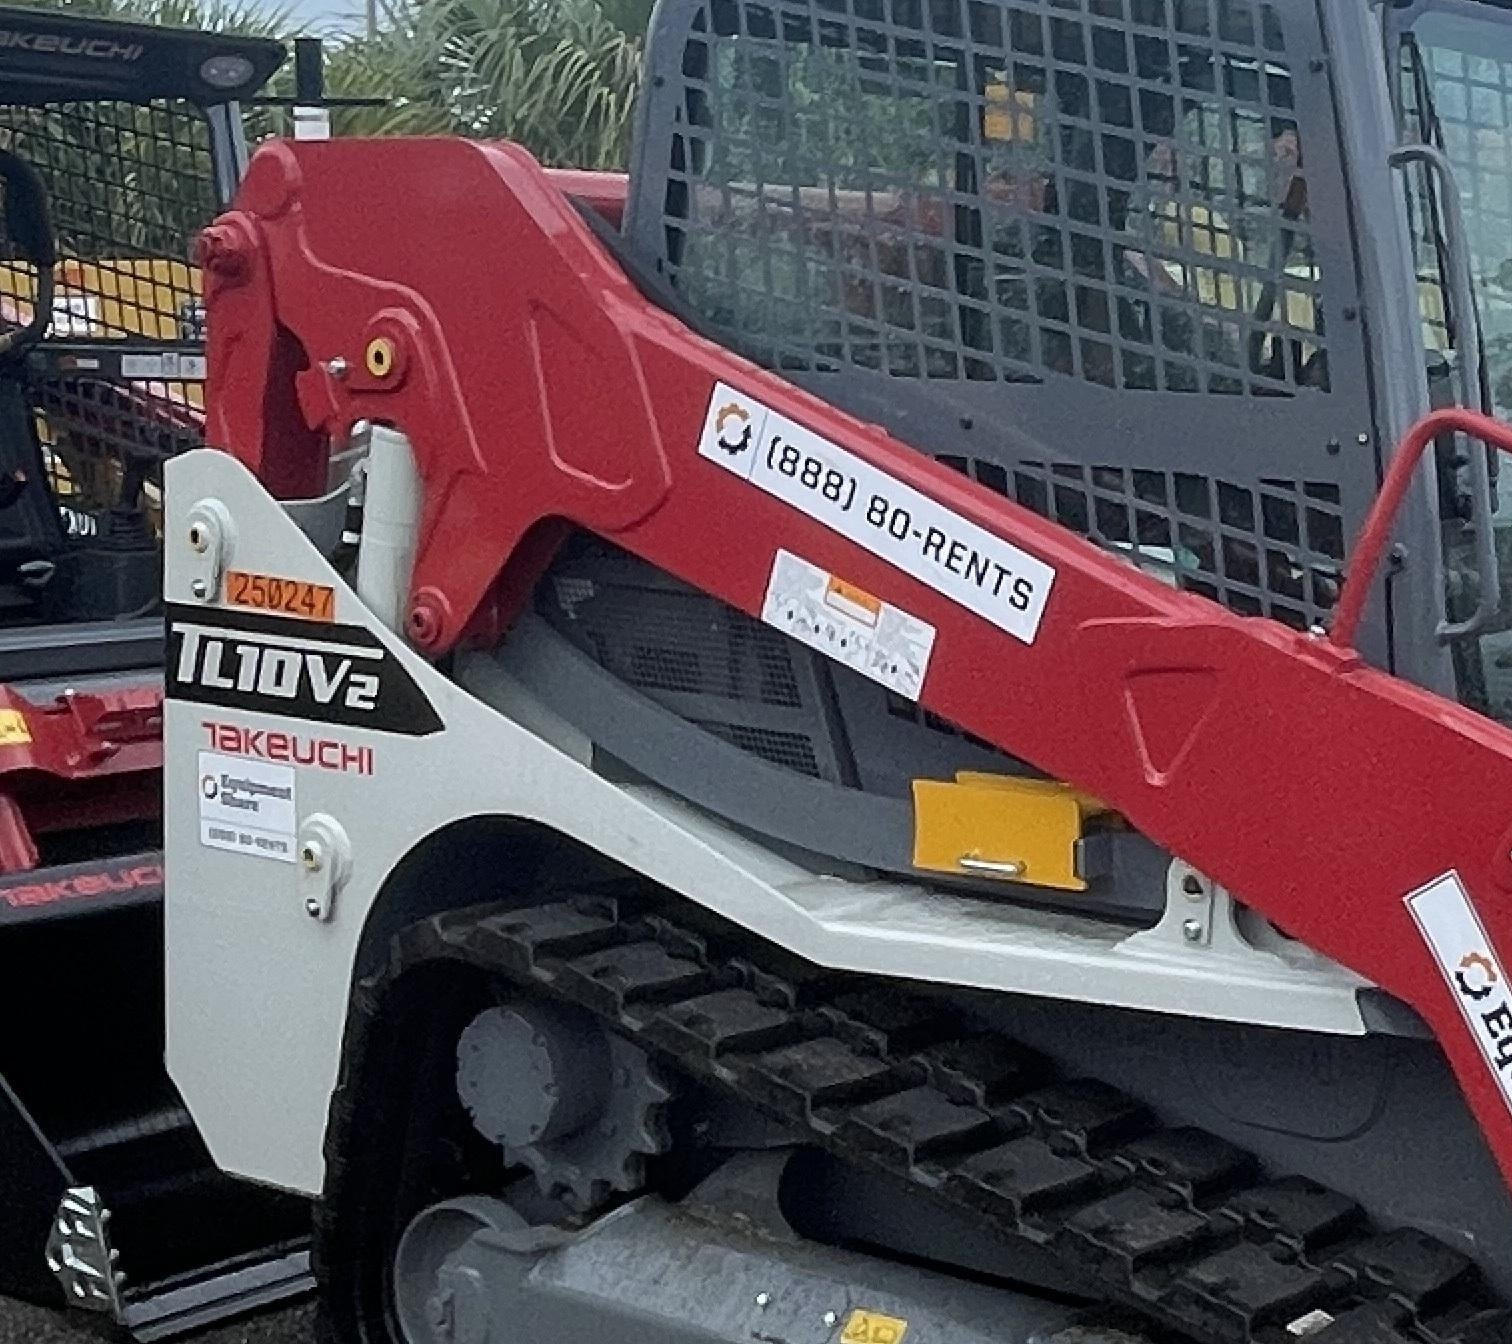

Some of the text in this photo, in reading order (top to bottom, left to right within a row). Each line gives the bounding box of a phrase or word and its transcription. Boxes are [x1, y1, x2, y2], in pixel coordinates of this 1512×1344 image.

[766, 436, 1034, 612] (888) 80-RENTS
[234, 572, 335, 618] 250247
[172, 622, 383, 710] TL10V2
[202, 721, 374, 775] TAKEUCHI
